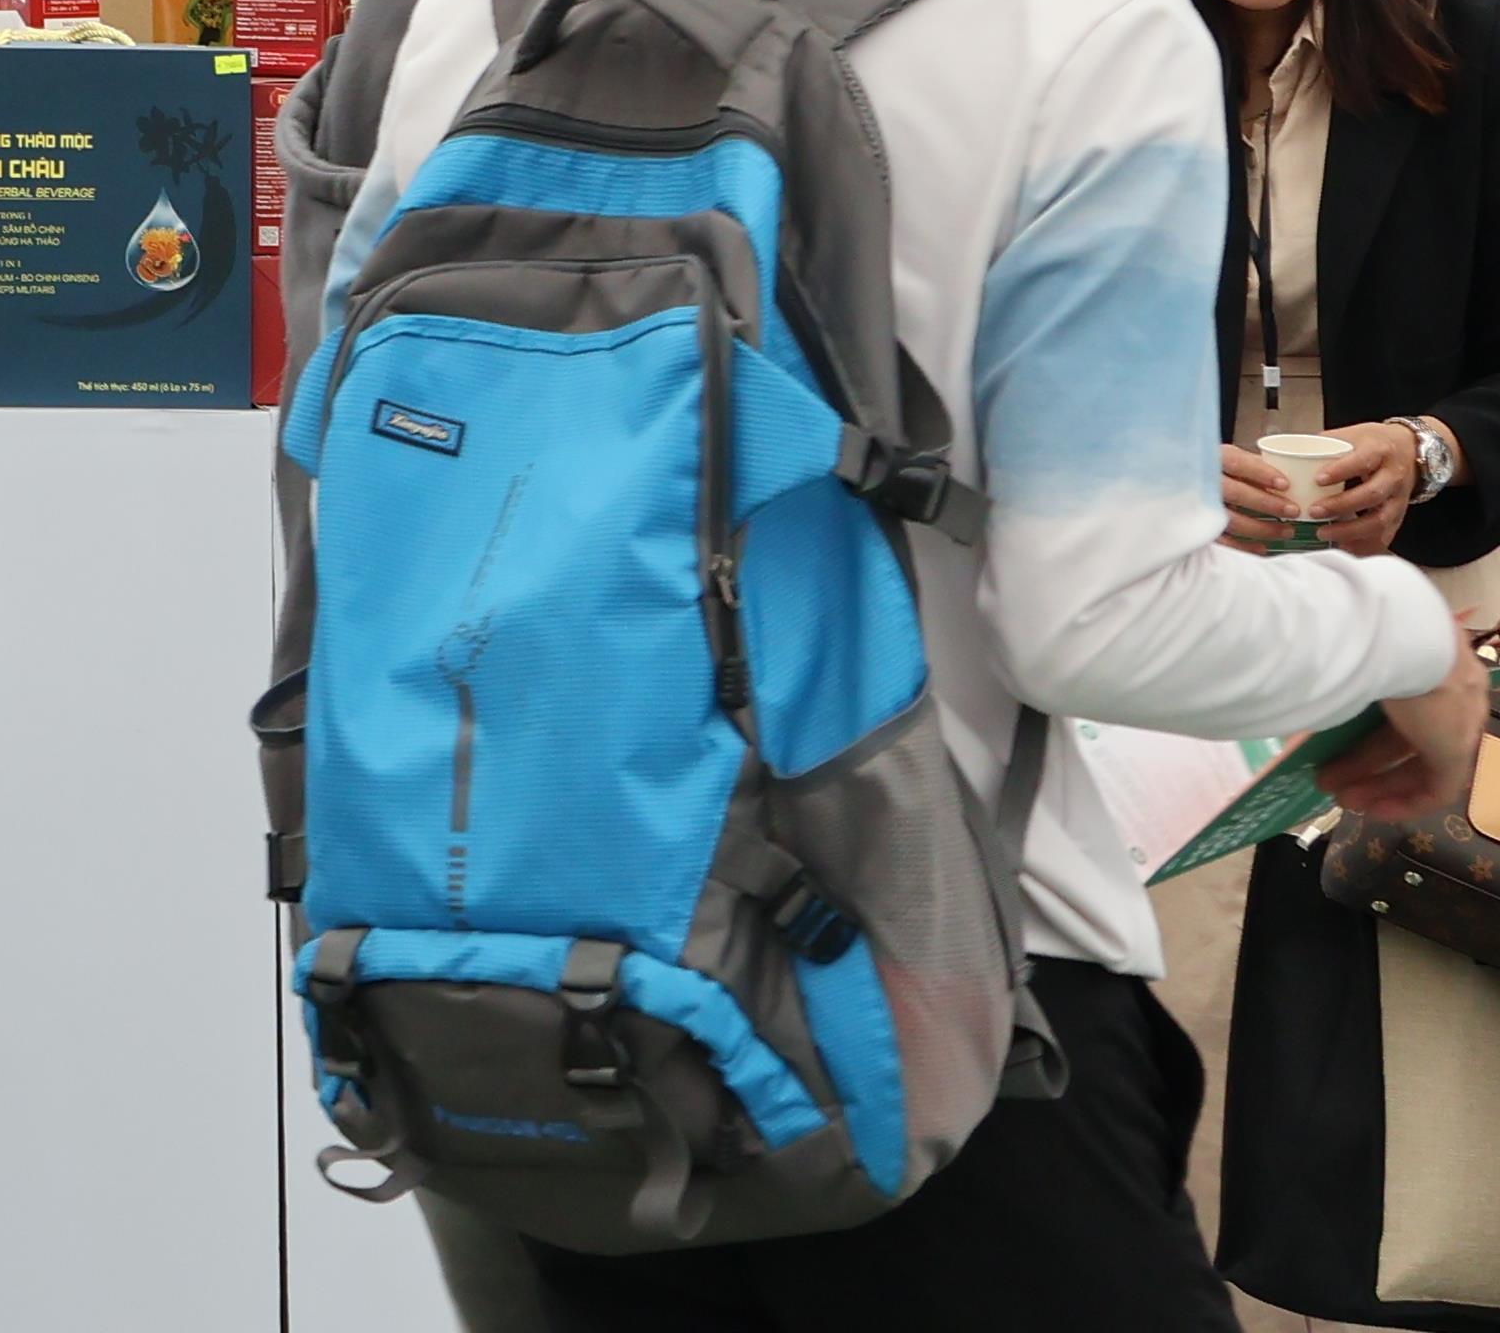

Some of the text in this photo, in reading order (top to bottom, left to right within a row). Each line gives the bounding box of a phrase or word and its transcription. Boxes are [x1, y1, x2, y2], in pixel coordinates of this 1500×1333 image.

[16, 132, 56, 149] THẢO
[60, 132, 94, 151] MỘC
[9, 156, 65, 179] CHÂU
[36, 188, 96, 199] BEVERAGE
